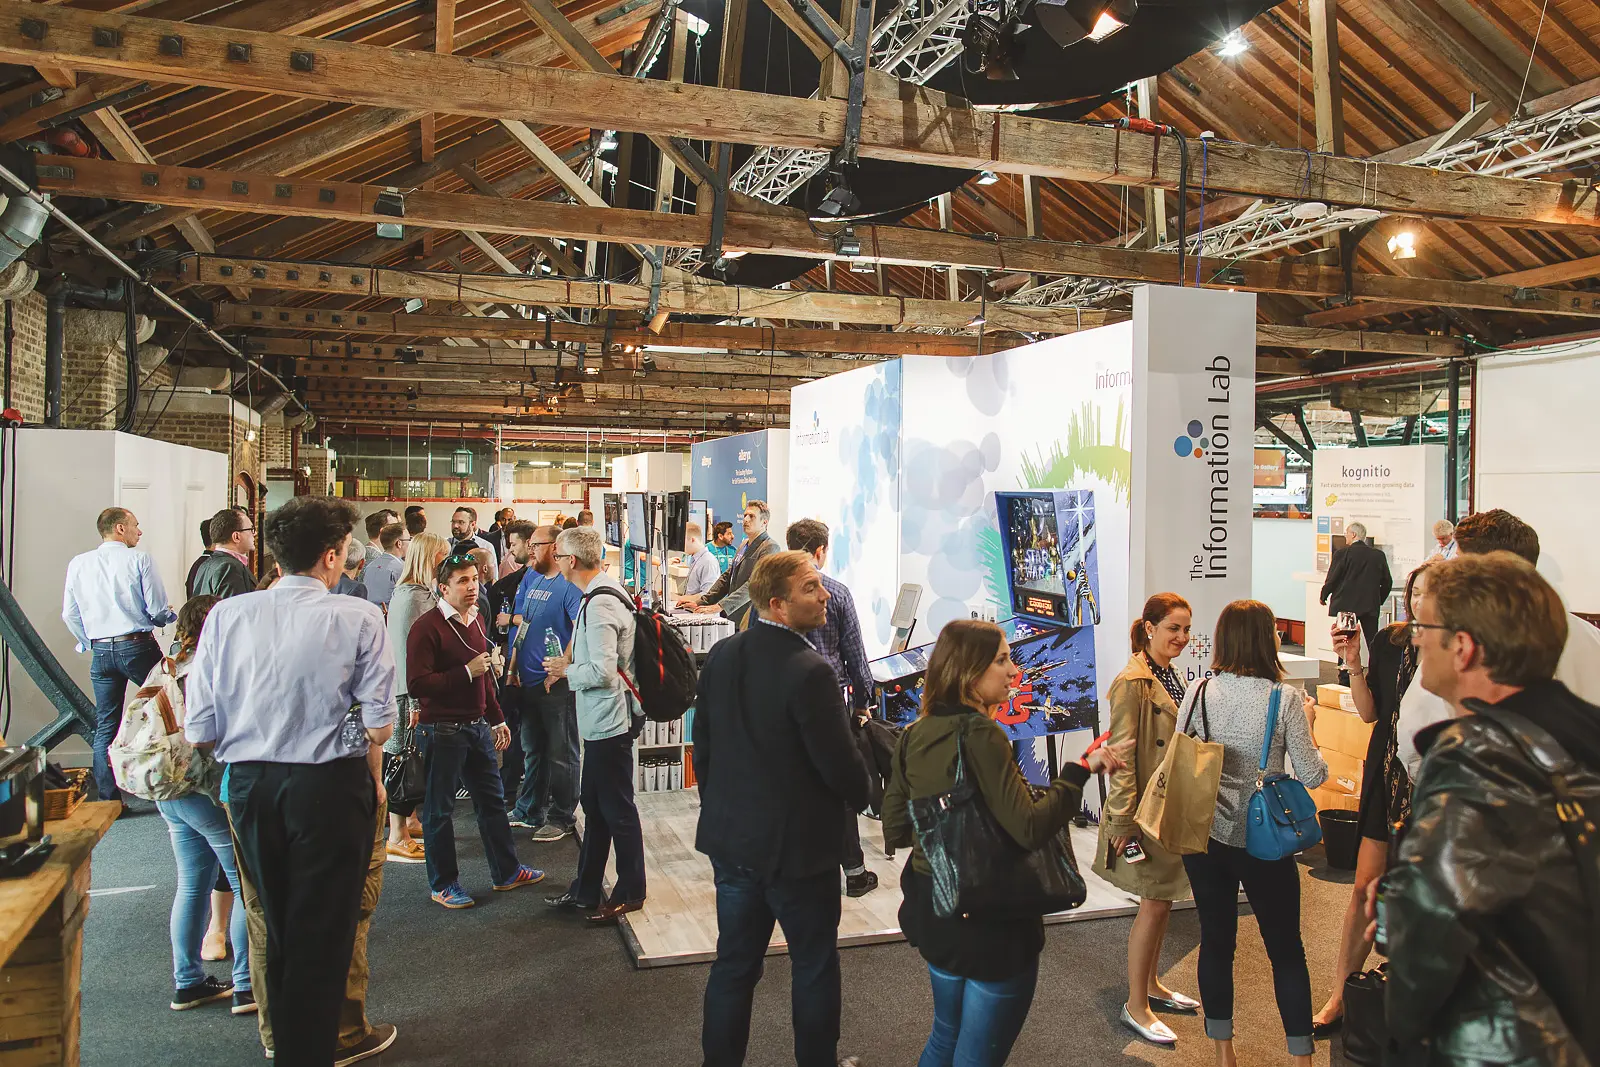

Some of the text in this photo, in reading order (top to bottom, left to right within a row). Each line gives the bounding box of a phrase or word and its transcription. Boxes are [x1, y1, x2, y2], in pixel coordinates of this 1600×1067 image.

[1095, 368, 1133, 390] Inform
[1202, 355, 1231, 579] Information Lab
[1342, 464, 1391, 481] kognitio
[1189, 555, 1203, 581] The
